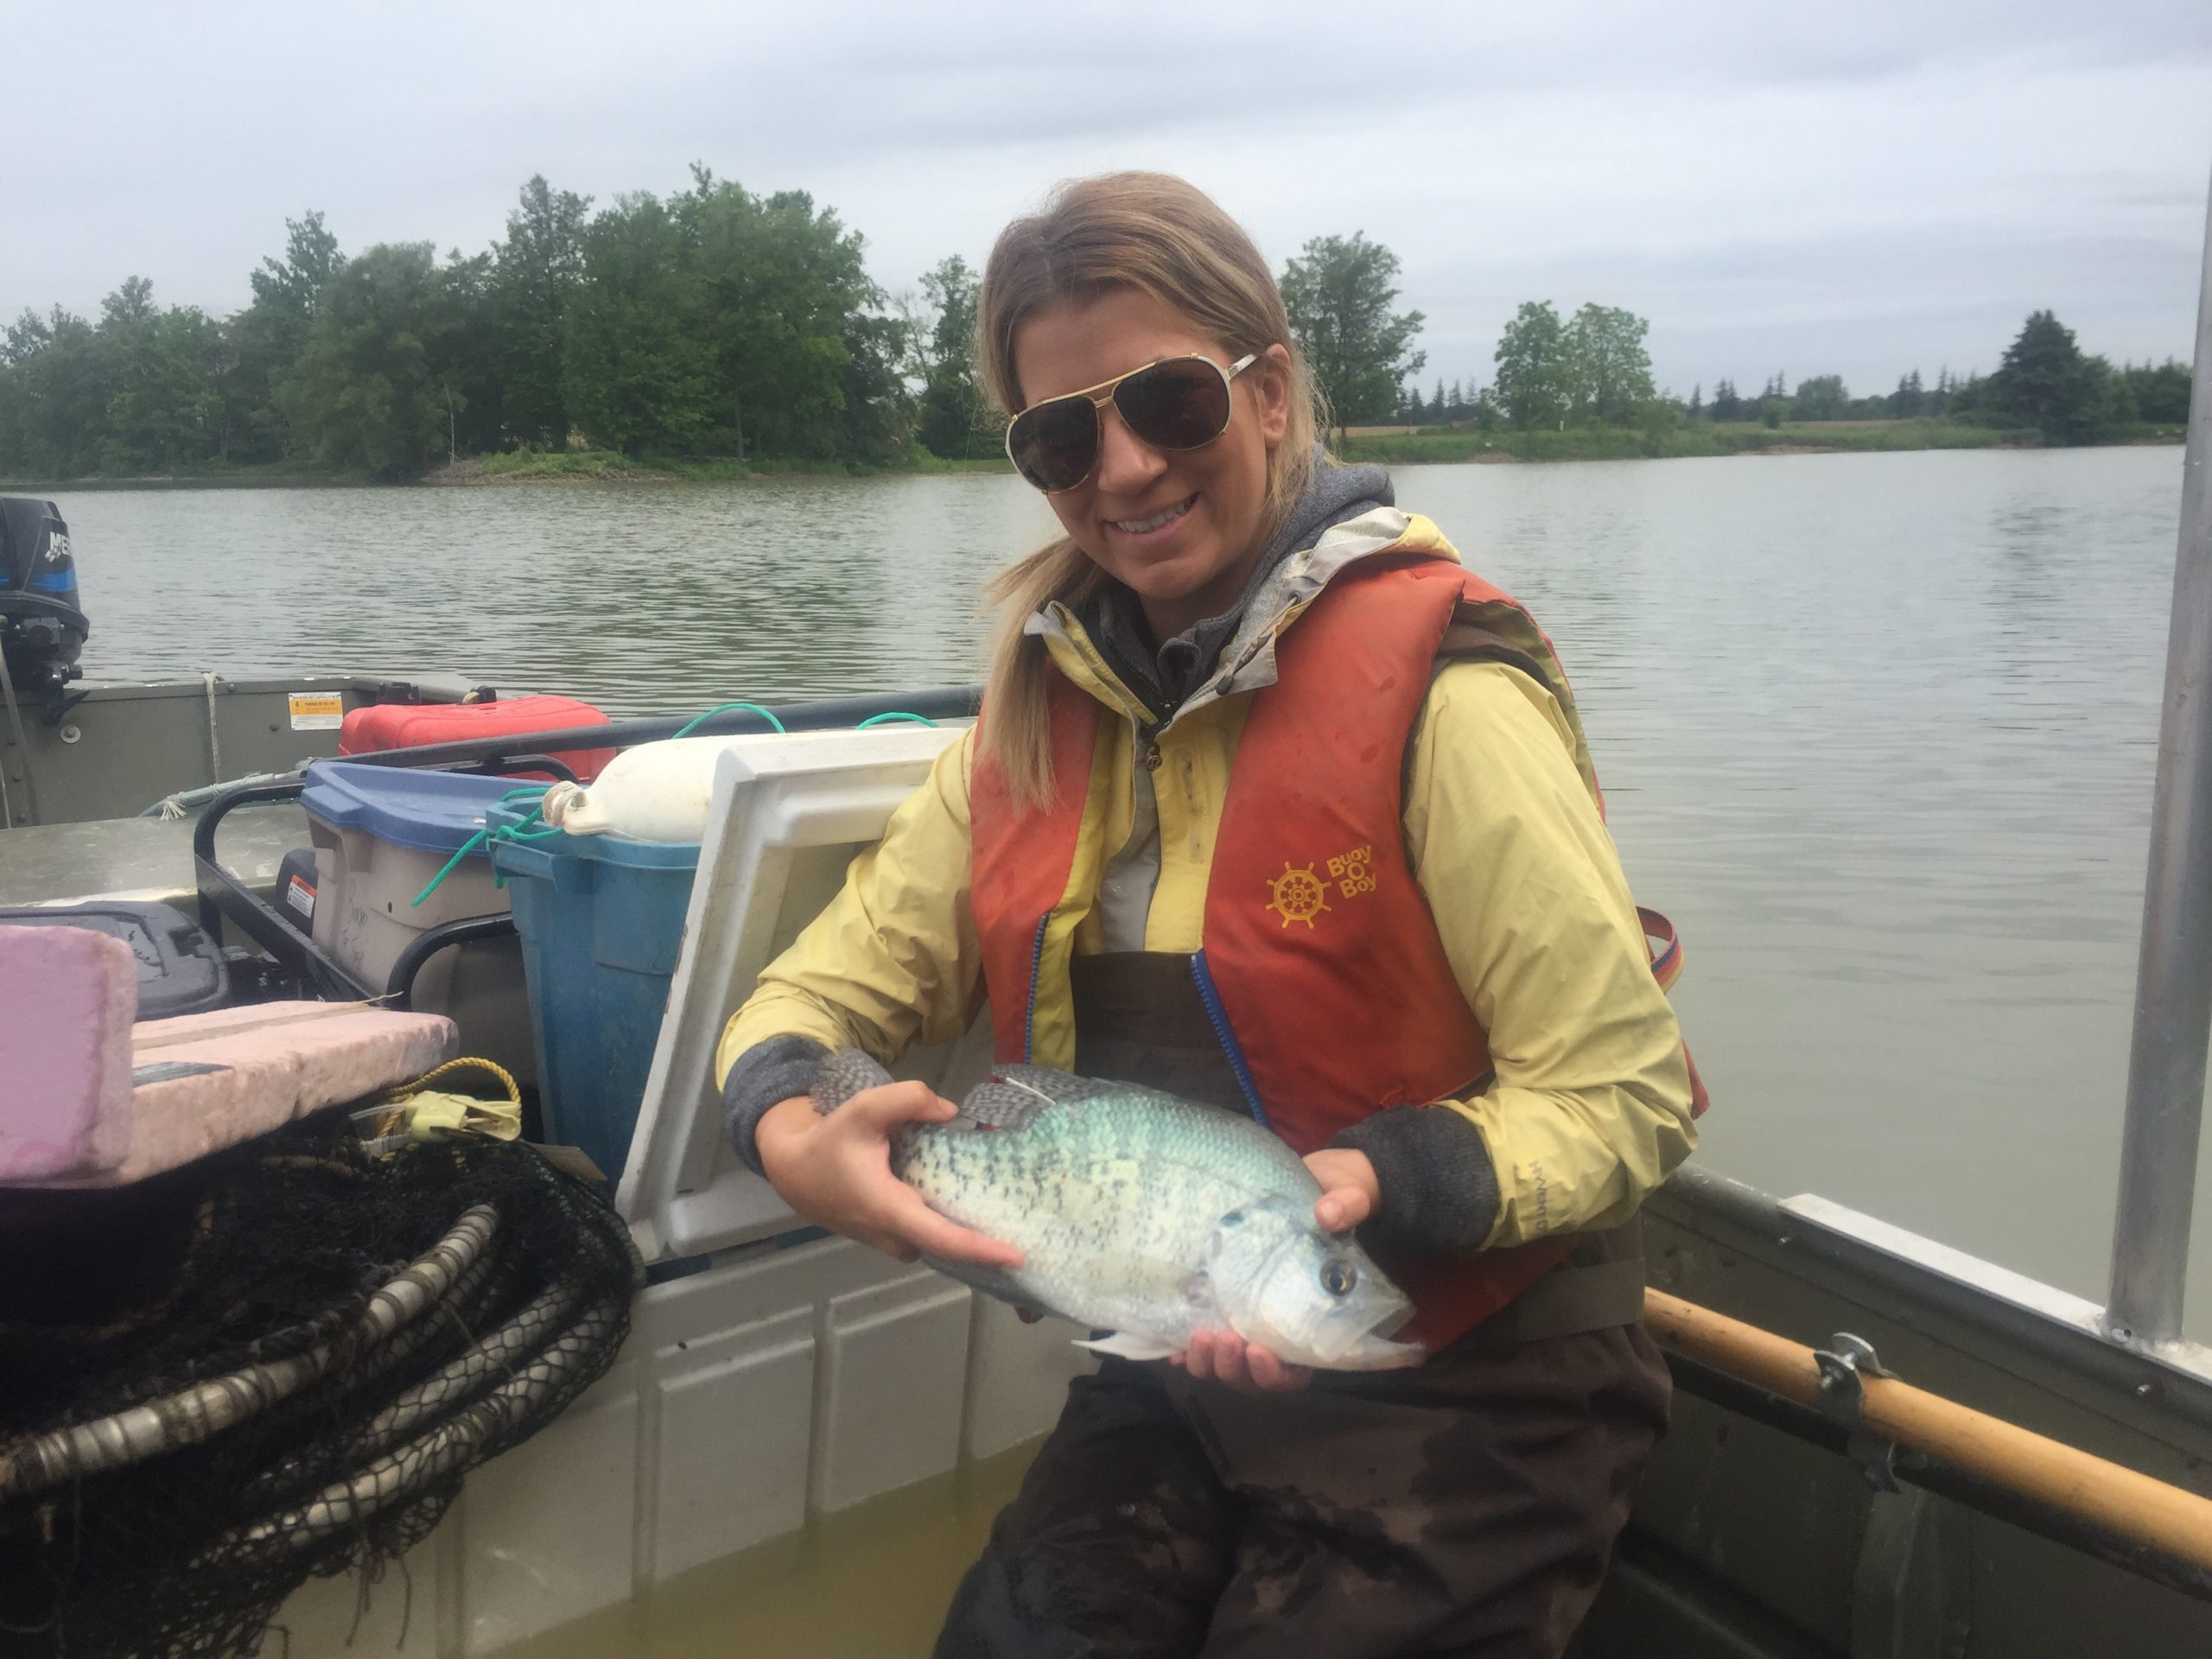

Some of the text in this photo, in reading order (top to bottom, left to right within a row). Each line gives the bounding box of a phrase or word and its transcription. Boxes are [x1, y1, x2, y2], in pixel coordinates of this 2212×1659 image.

[1326, 844, 1371, 877] Buoy
[1347, 862, 1365, 880] O
[1339, 873, 1376, 899] Boy
